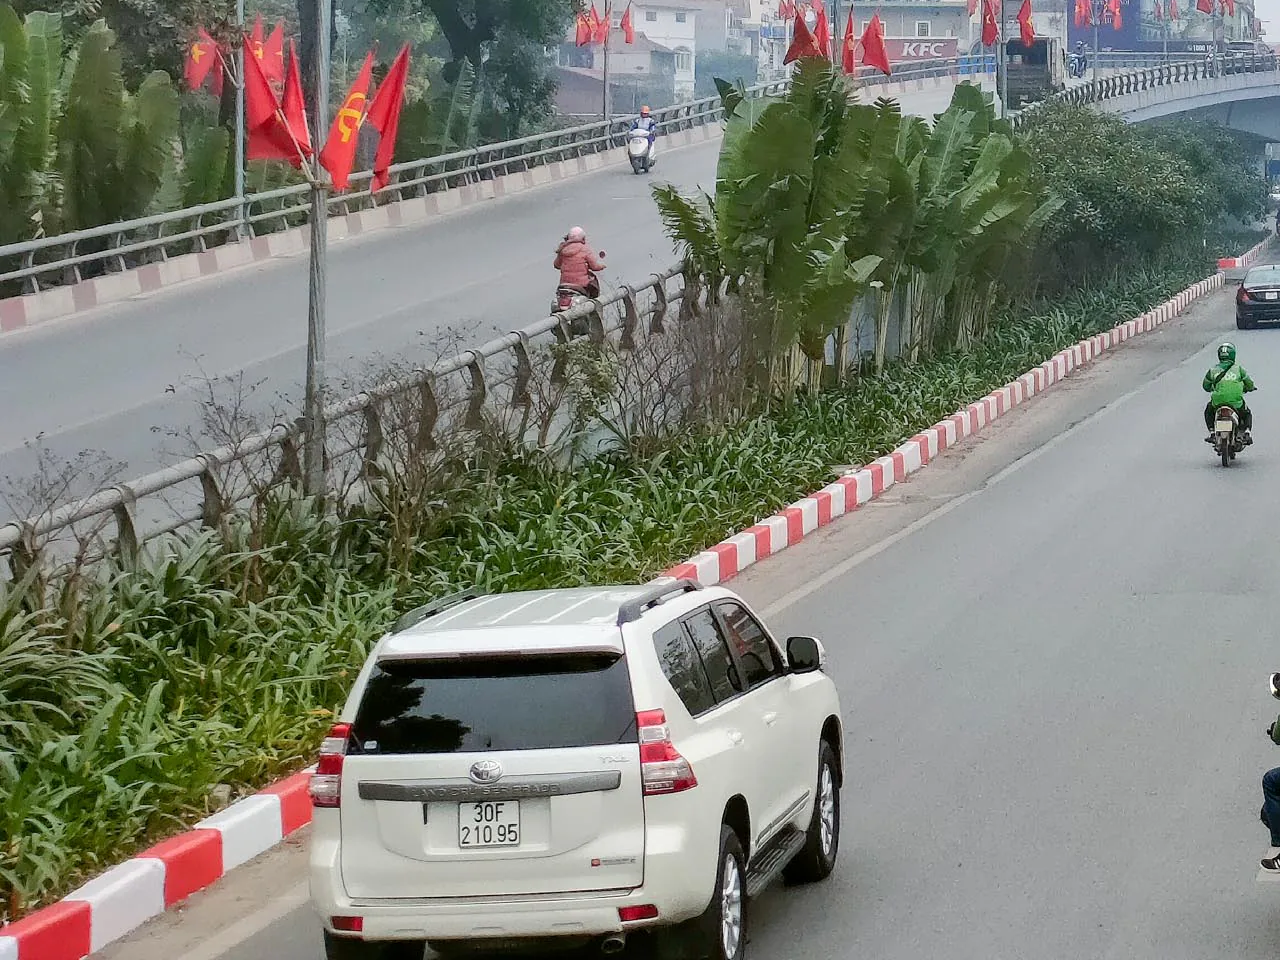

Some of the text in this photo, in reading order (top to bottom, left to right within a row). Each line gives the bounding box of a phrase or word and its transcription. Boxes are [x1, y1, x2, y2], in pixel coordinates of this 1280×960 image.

[902, 42, 944, 57] KFC
[411, 782, 560, 797] LAND CRUISER PRADO
[473, 803, 505, 823] 30F
[461, 823, 519, 845] 210.95
